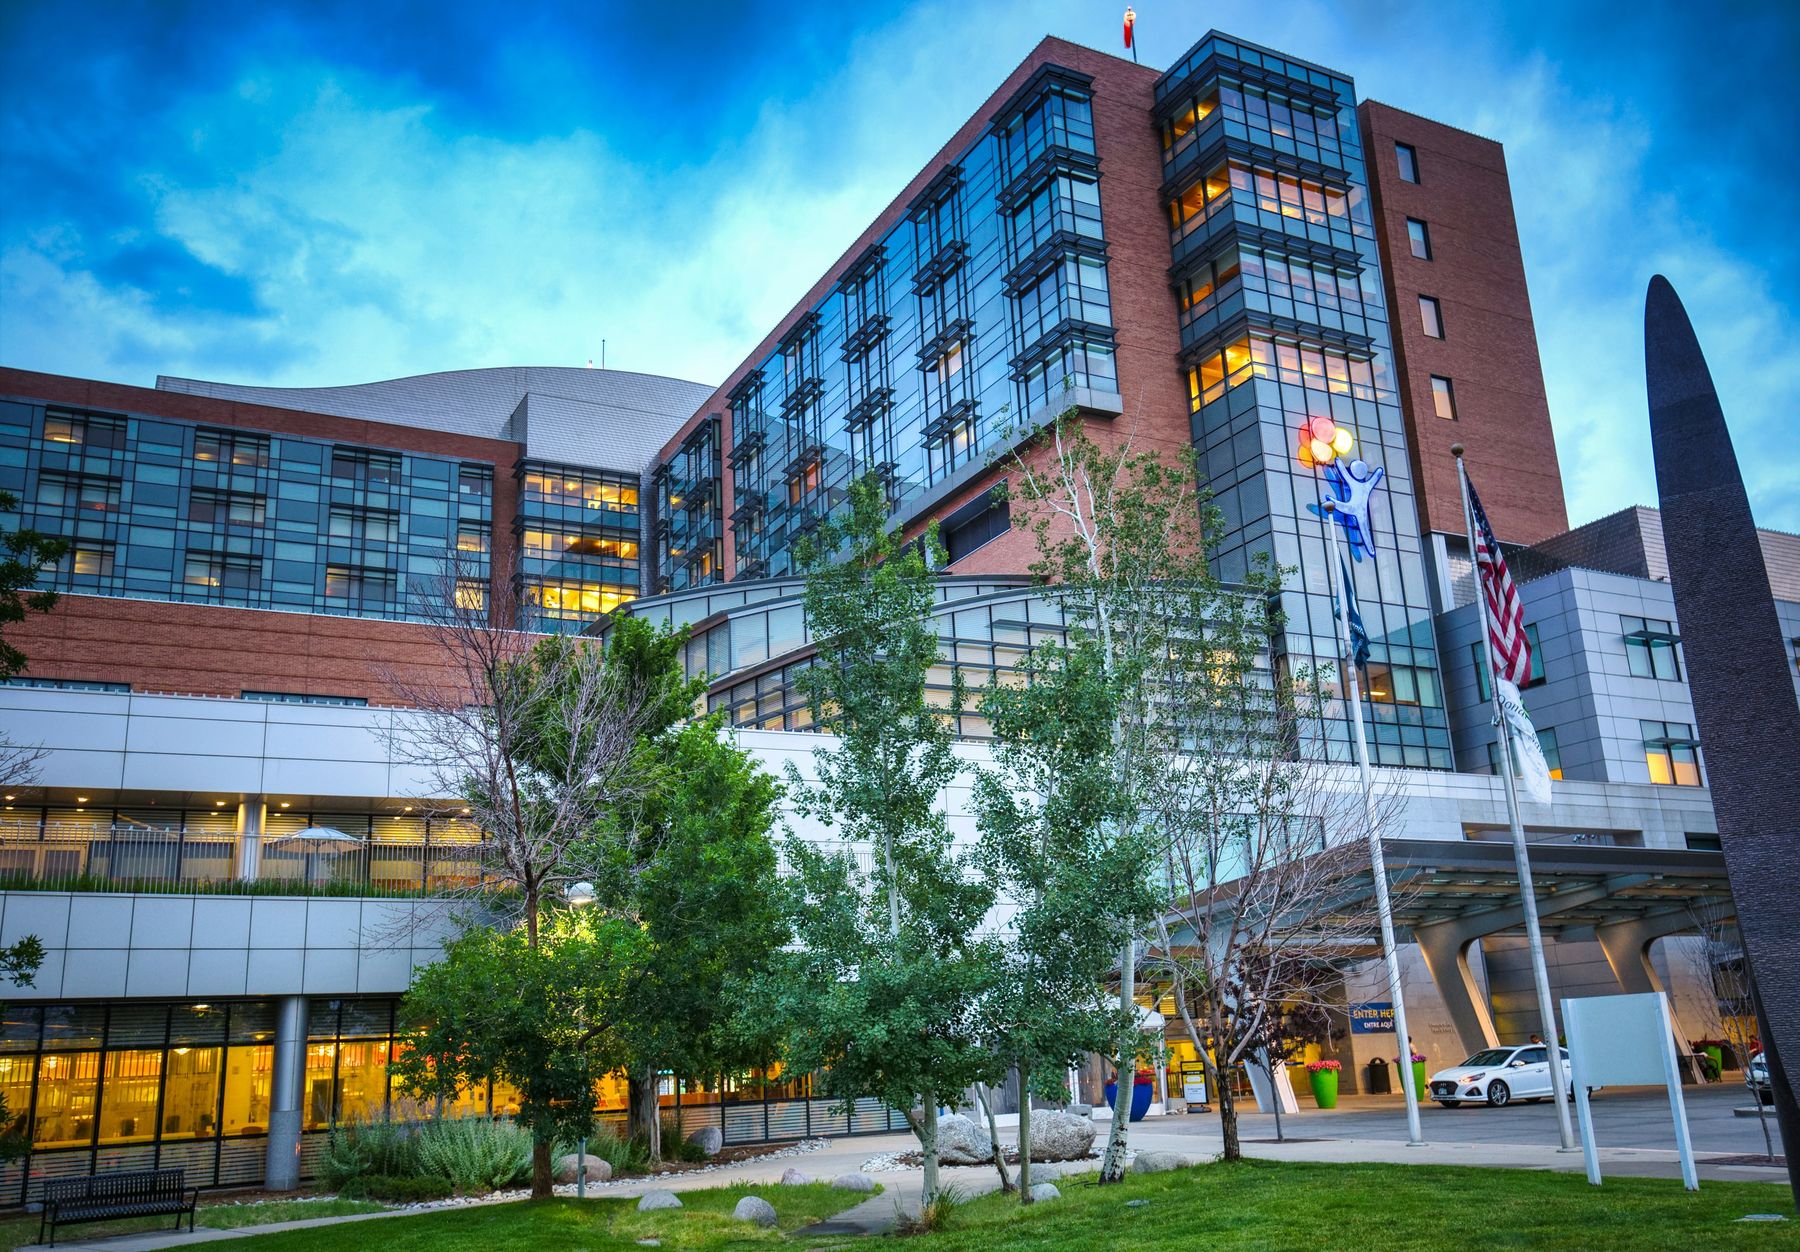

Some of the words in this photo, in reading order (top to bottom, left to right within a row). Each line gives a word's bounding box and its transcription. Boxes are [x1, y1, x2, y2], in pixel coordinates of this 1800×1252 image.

[1353, 1009, 1378, 1019] ENTER
[1380, 1008, 1395, 1018] HER
[1363, 1021, 1379, 1029] ENTRE
